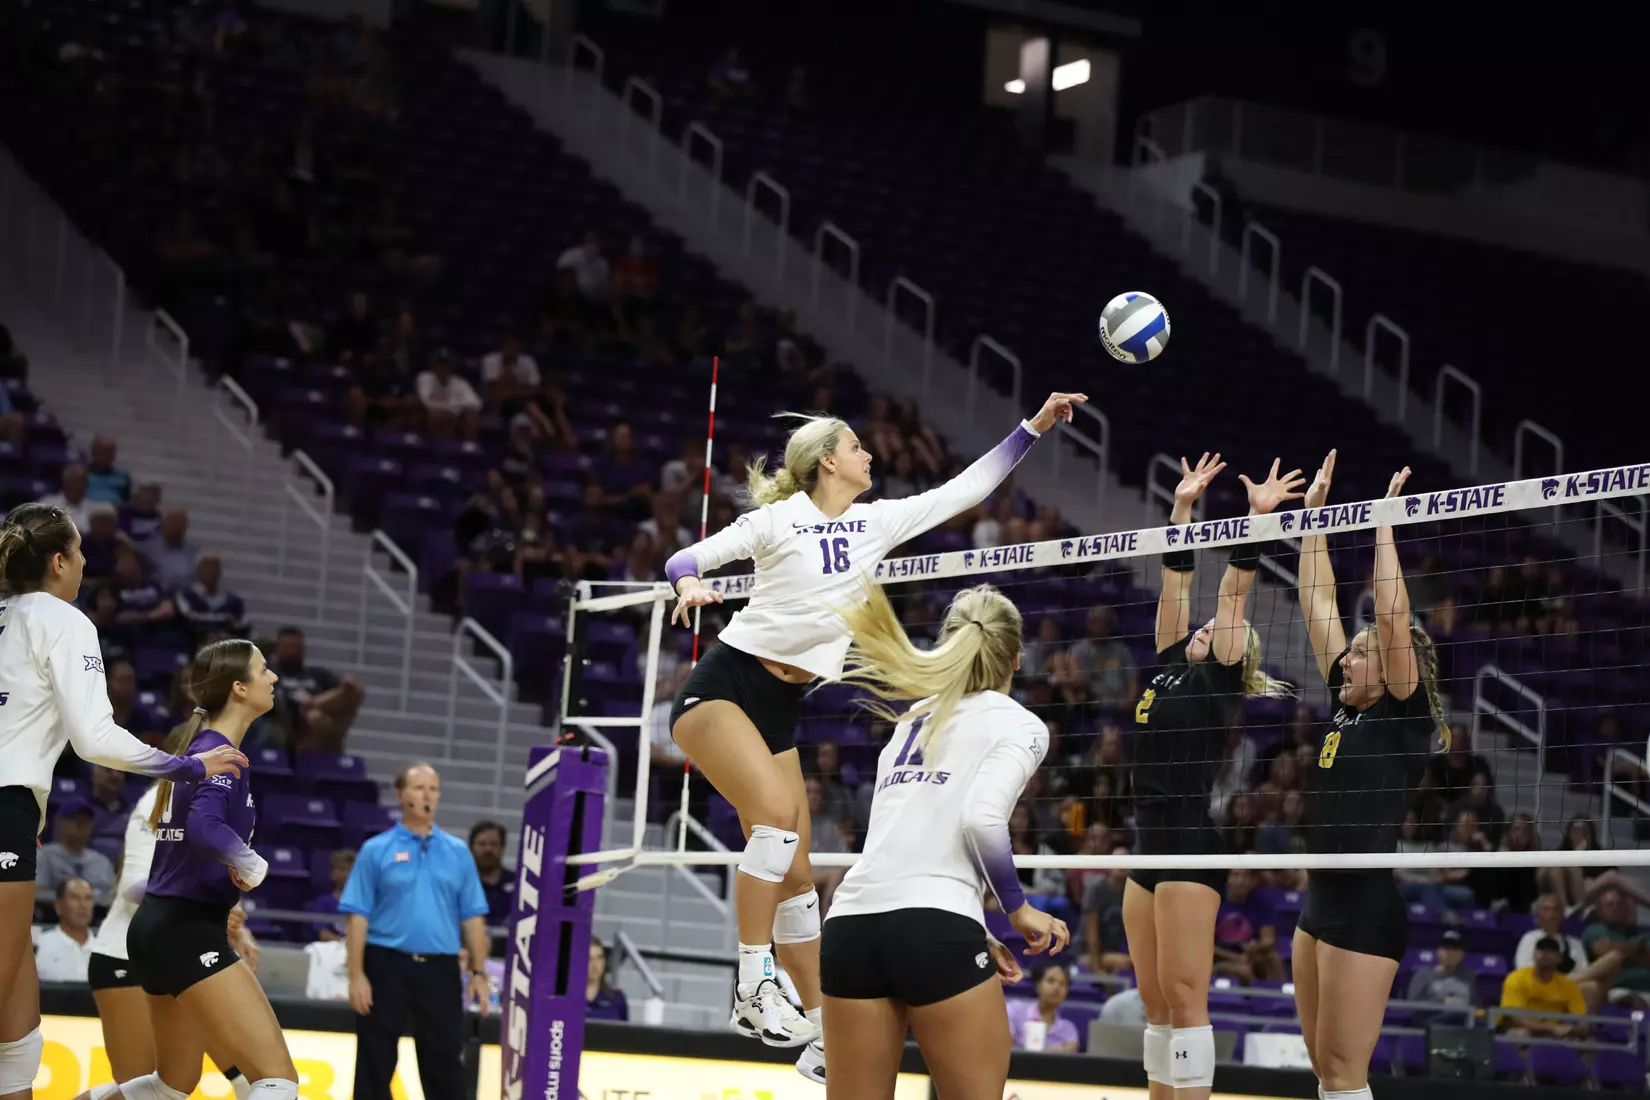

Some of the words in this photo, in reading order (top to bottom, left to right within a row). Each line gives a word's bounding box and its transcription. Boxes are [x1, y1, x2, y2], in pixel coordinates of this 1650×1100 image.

[1344, 26, 1386, 74] 9
[1100, 326, 1127, 360] molten
[1565, 465, 1650, 497] K-STATE
[1427, 485, 1505, 515] K-STATE
[1184, 518, 1251, 544] K-STATE
[1300, 502, 1372, 530] K-STATE
[820, 537, 851, 574] 16
[980, 545, 1034, 568] K-STATE
[1077, 533, 1138, 557] K-STATE
[888, 556, 940, 578] K-STATE
[1136, 688, 1156, 723] 2
[548, 1020, 564, 1070] sports
